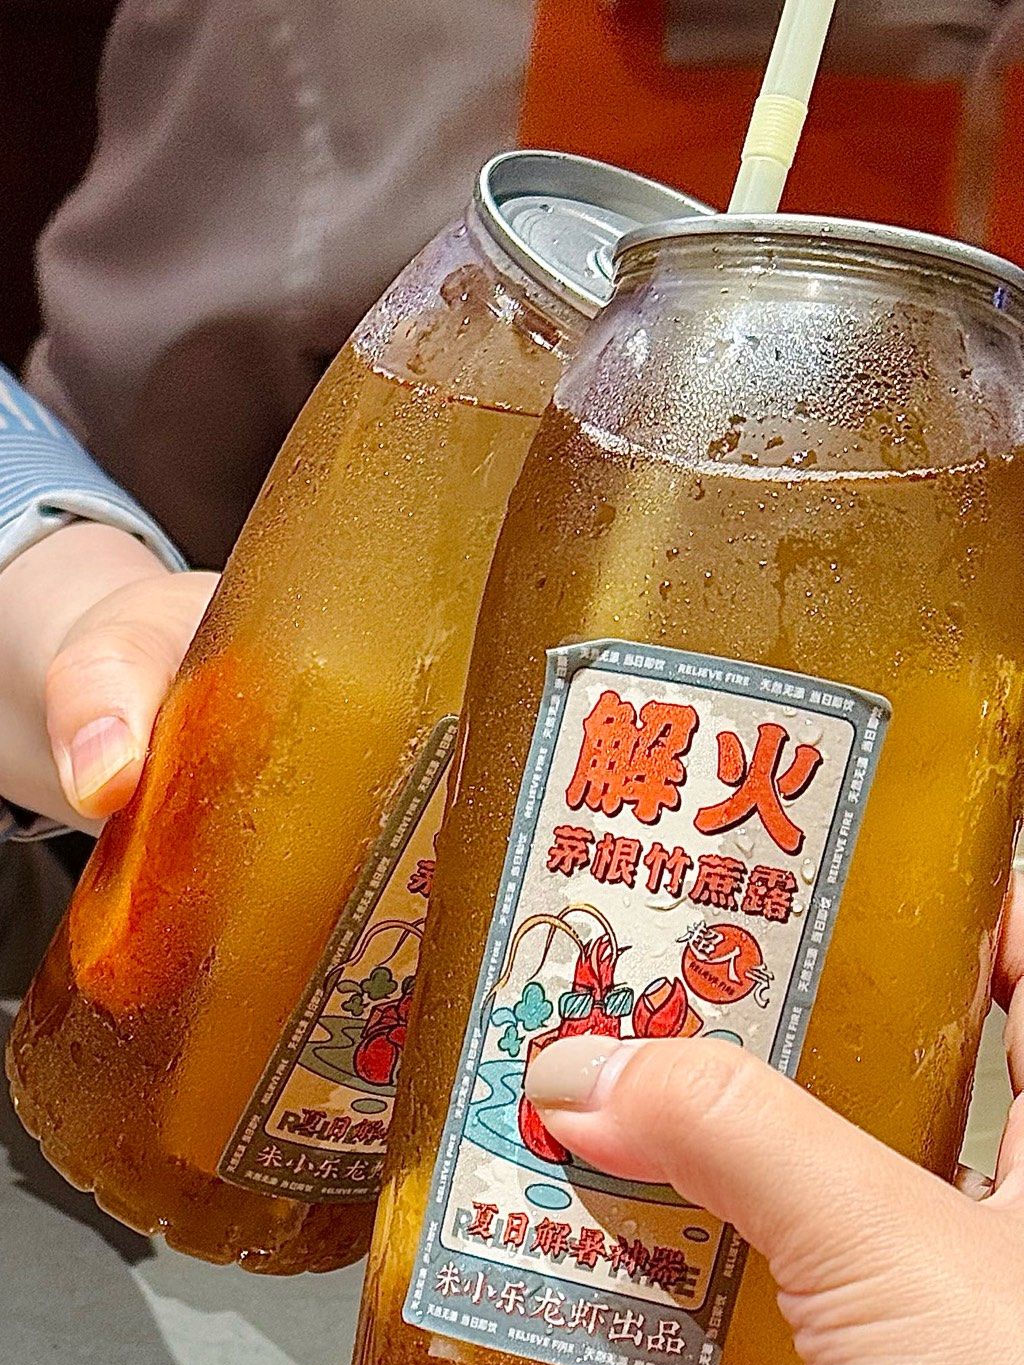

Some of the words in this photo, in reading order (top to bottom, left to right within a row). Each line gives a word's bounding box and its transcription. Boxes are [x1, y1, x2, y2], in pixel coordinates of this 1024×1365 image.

[566, 690, 823, 856] 解火
[546, 825, 798, 923] 茅根竹蔗露
[827, 837, 848, 884] RELIEVE
[840, 811, 854, 837] FIRE
[435, 1261, 686, 1355] 朱小乐龙虾出品
